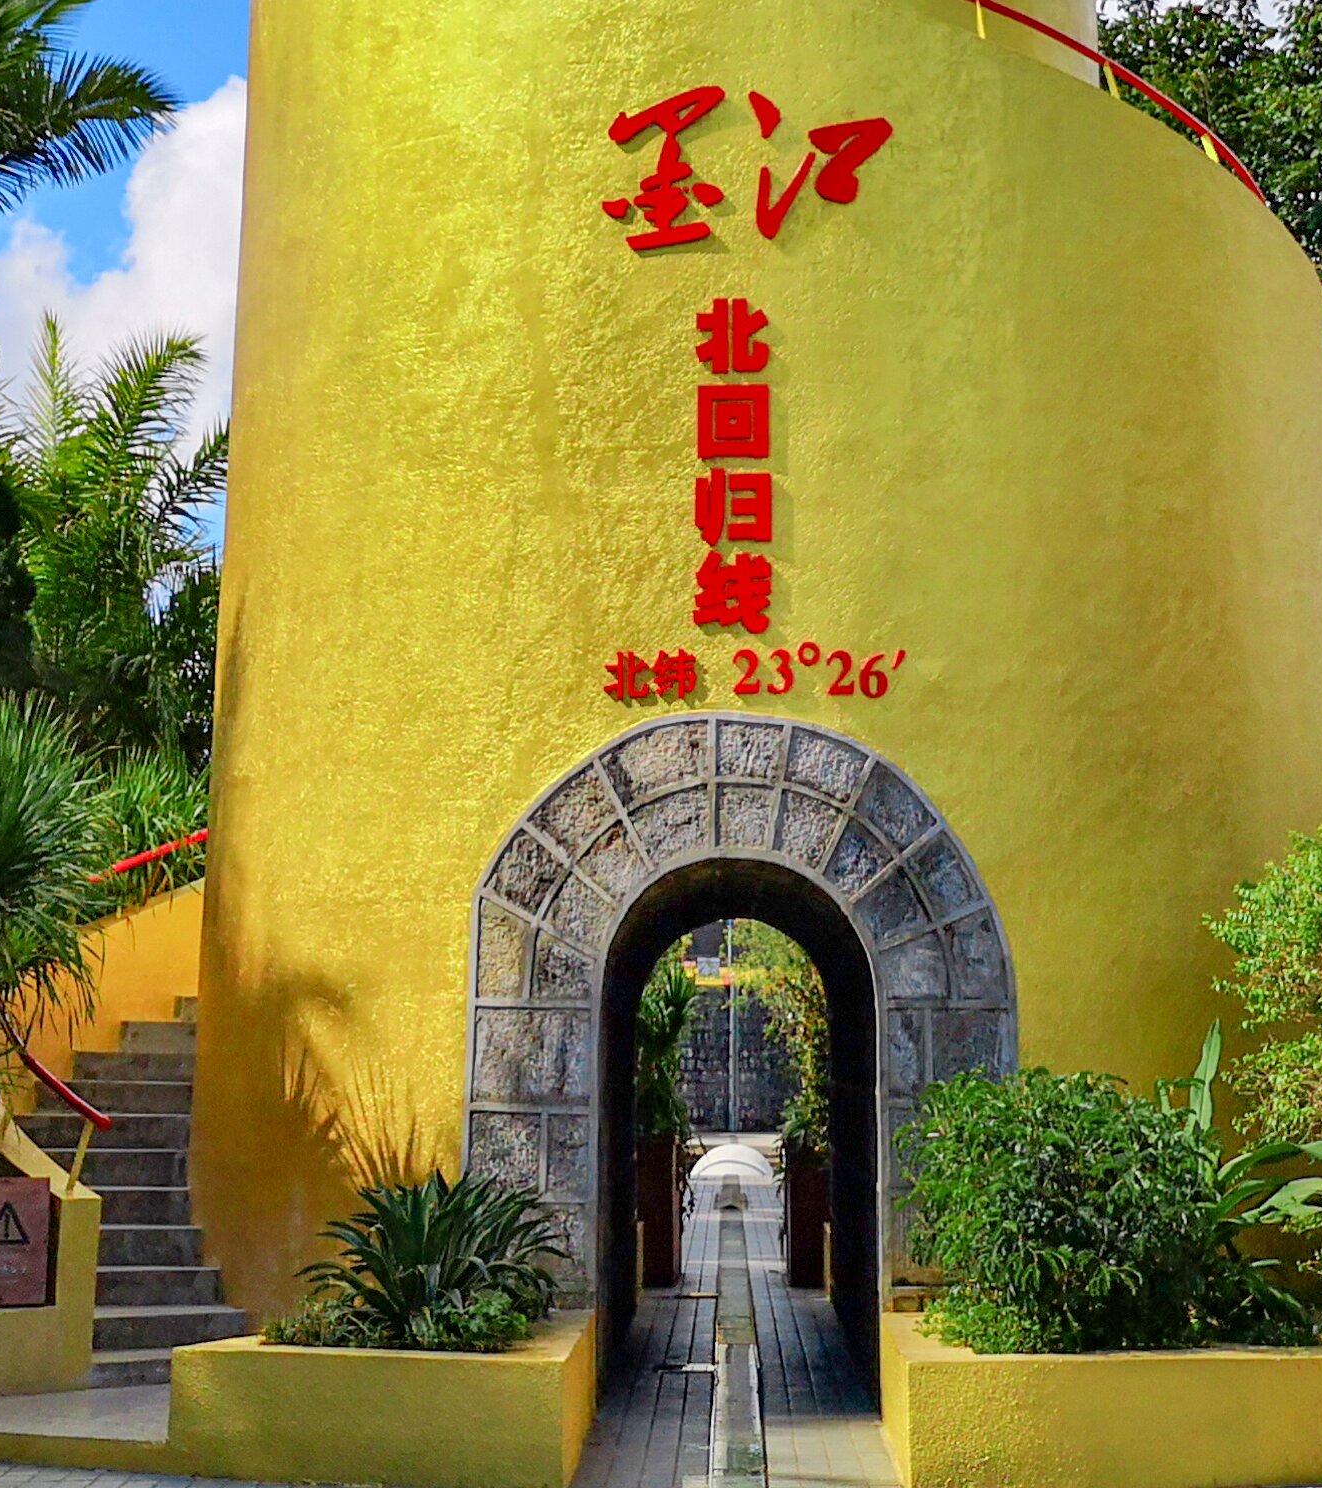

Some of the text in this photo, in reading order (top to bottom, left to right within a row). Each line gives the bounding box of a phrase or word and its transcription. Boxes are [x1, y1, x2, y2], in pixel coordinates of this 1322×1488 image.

[601, 85, 895, 251] 墨江
[691, 297, 774, 635] 北回归线
[602, 647, 698, 701] 北纬
